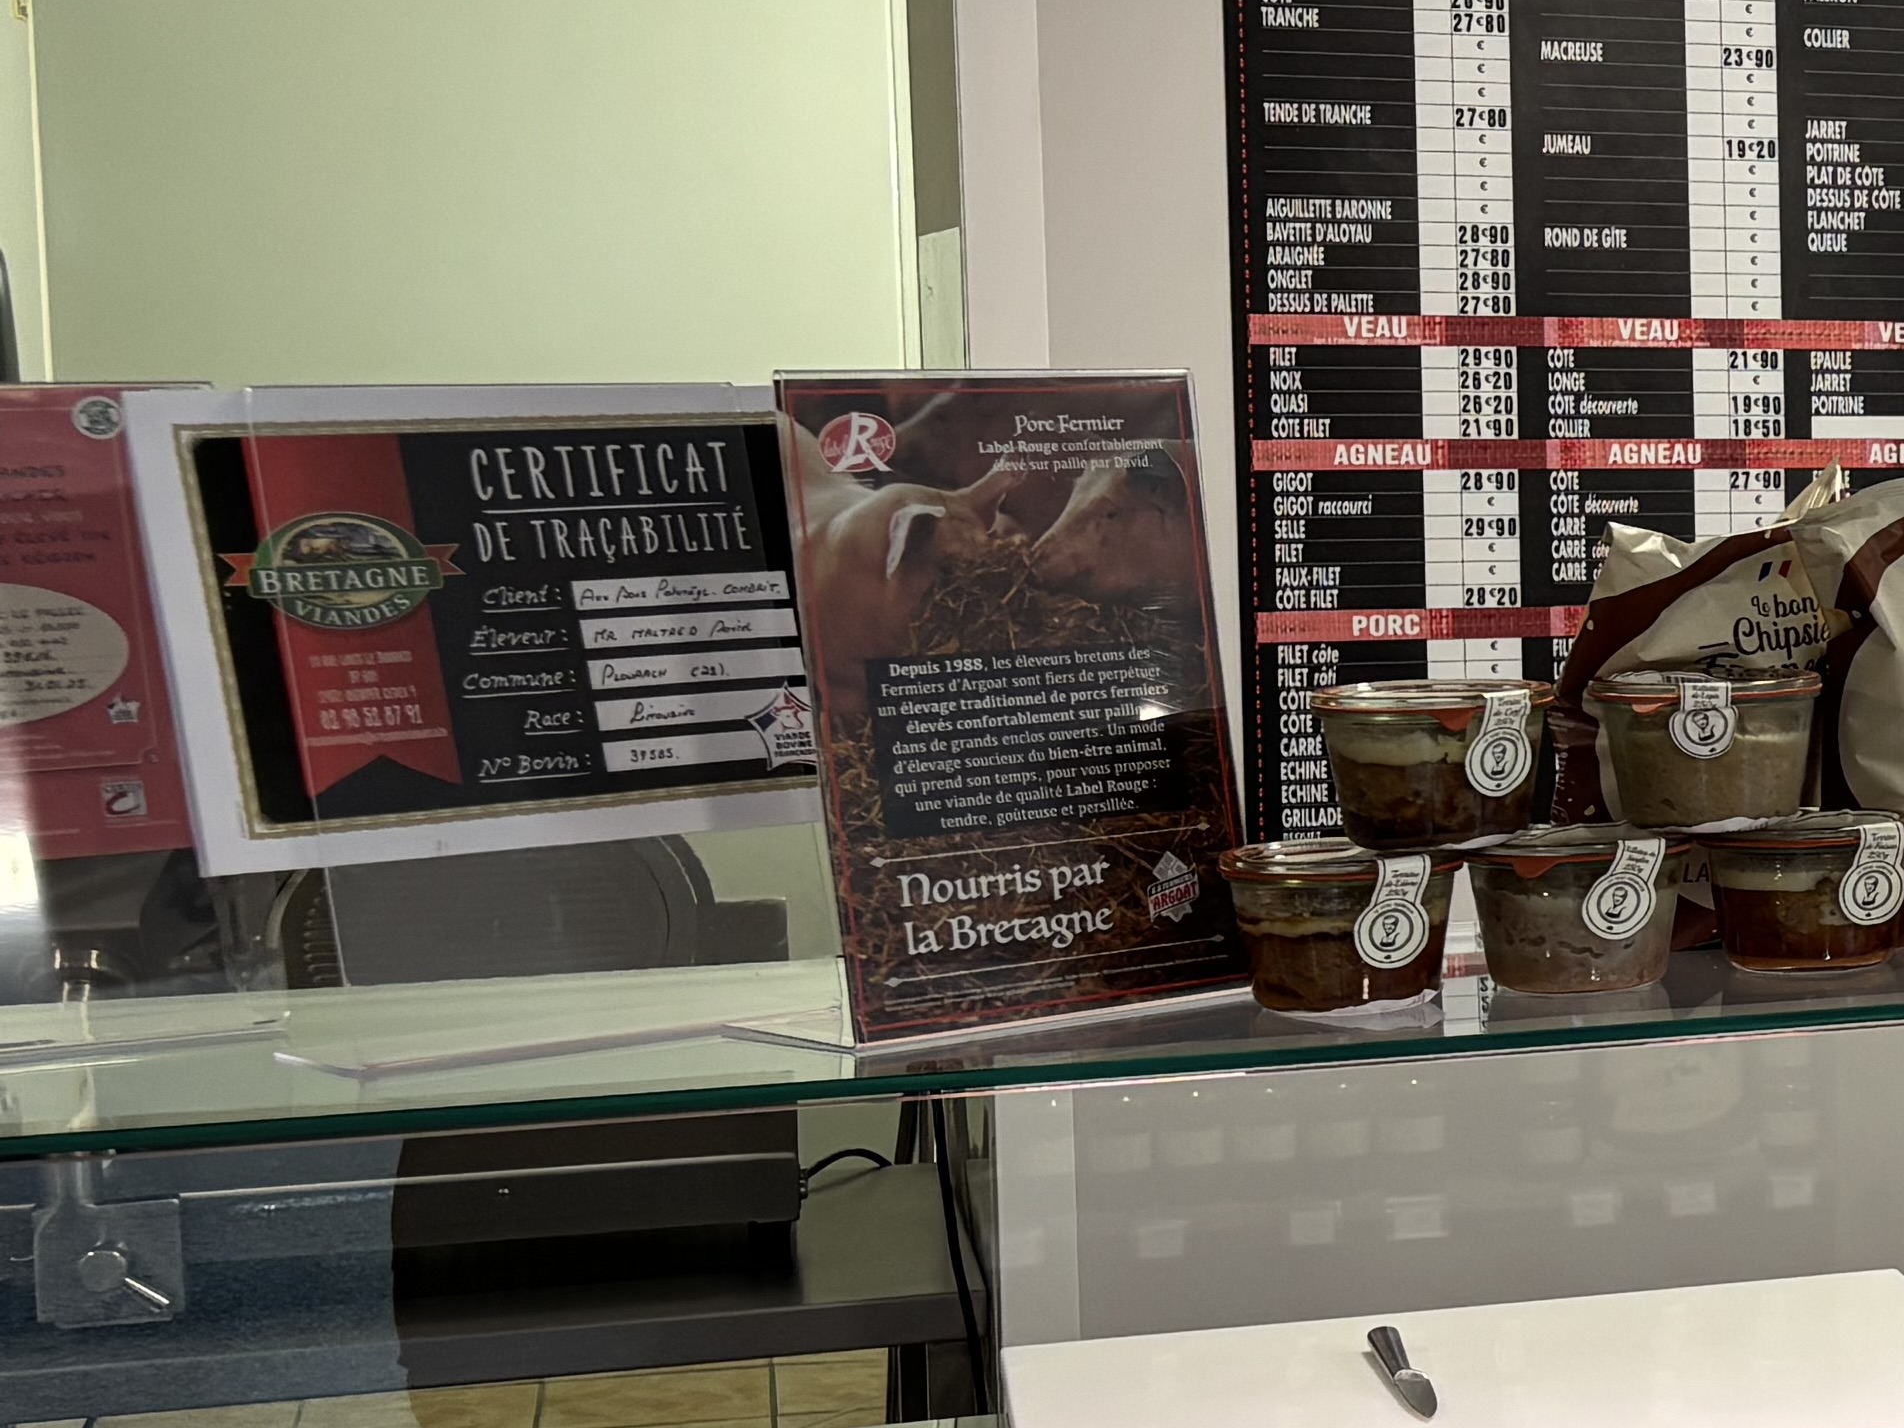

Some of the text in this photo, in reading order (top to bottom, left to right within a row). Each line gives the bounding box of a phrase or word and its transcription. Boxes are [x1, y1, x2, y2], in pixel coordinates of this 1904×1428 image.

[1261, 7, 1319, 28] TRANCHE
[1804, 29, 1850, 49] COLLIER
[1541, 41, 1603, 62] MACREUSE
[1264, 102, 1371, 124] TENDE DE TRANCHE
[1806, 120, 1847, 140] JARRET
[1543, 135, 1591, 155] JUMEAU
[1806, 143, 1860, 163] POITRINE
[1266, 199, 1392, 221] AIGUILLETTE BARONNE
[1808, 211, 1866, 230] FLANCHET
[1266, 223, 1372, 244] BAVETTE D'ALOYAU
[1808, 233, 1848, 252] QUEUE
[1267, 245, 1325, 266] ARAIGNÉE
[1268, 270, 1312, 289] ONGLET
[1268, 293, 1374, 313] DESSUS DE PALETTE
[1343, 315, 1408, 338] VEAU
[1013, 414, 1124, 437] Porc Fermier
[978, 439, 1163, 454] Label Rouge confortablement
[1334, 443, 1431, 466] AGNEAU
[471, 442, 728, 501] CERTIFICAT
[1029, 458, 1051, 470] sur
[1053, 454, 1088, 472] paille
[1091, 456, 1112, 471] par
[1114, 454, 1153, 469] David.
[1273, 494, 1372, 516] GIGOT raccourci
[1550, 493, 1639, 514] CÔTE découverte
[473, 505, 752, 564] DE TRAÇABILITÉ
[1274, 520, 1306, 539] SELLE
[258, 565, 431, 594] BRETAGNE
[294, 594, 410, 625] VIANDES
[1352, 614, 1420, 636] PORC
[889, 647, 1150, 680] Depuis 1988, les éleveurs bretons des
[1278, 645, 1339, 665] FILET côte
[881, 665, 1161, 698] Fermiers d'Argoat sont fiers de perpétuer
[897, 855, 1111, 910] Nourris par
[904, 905, 1116, 956] la Bretagne
